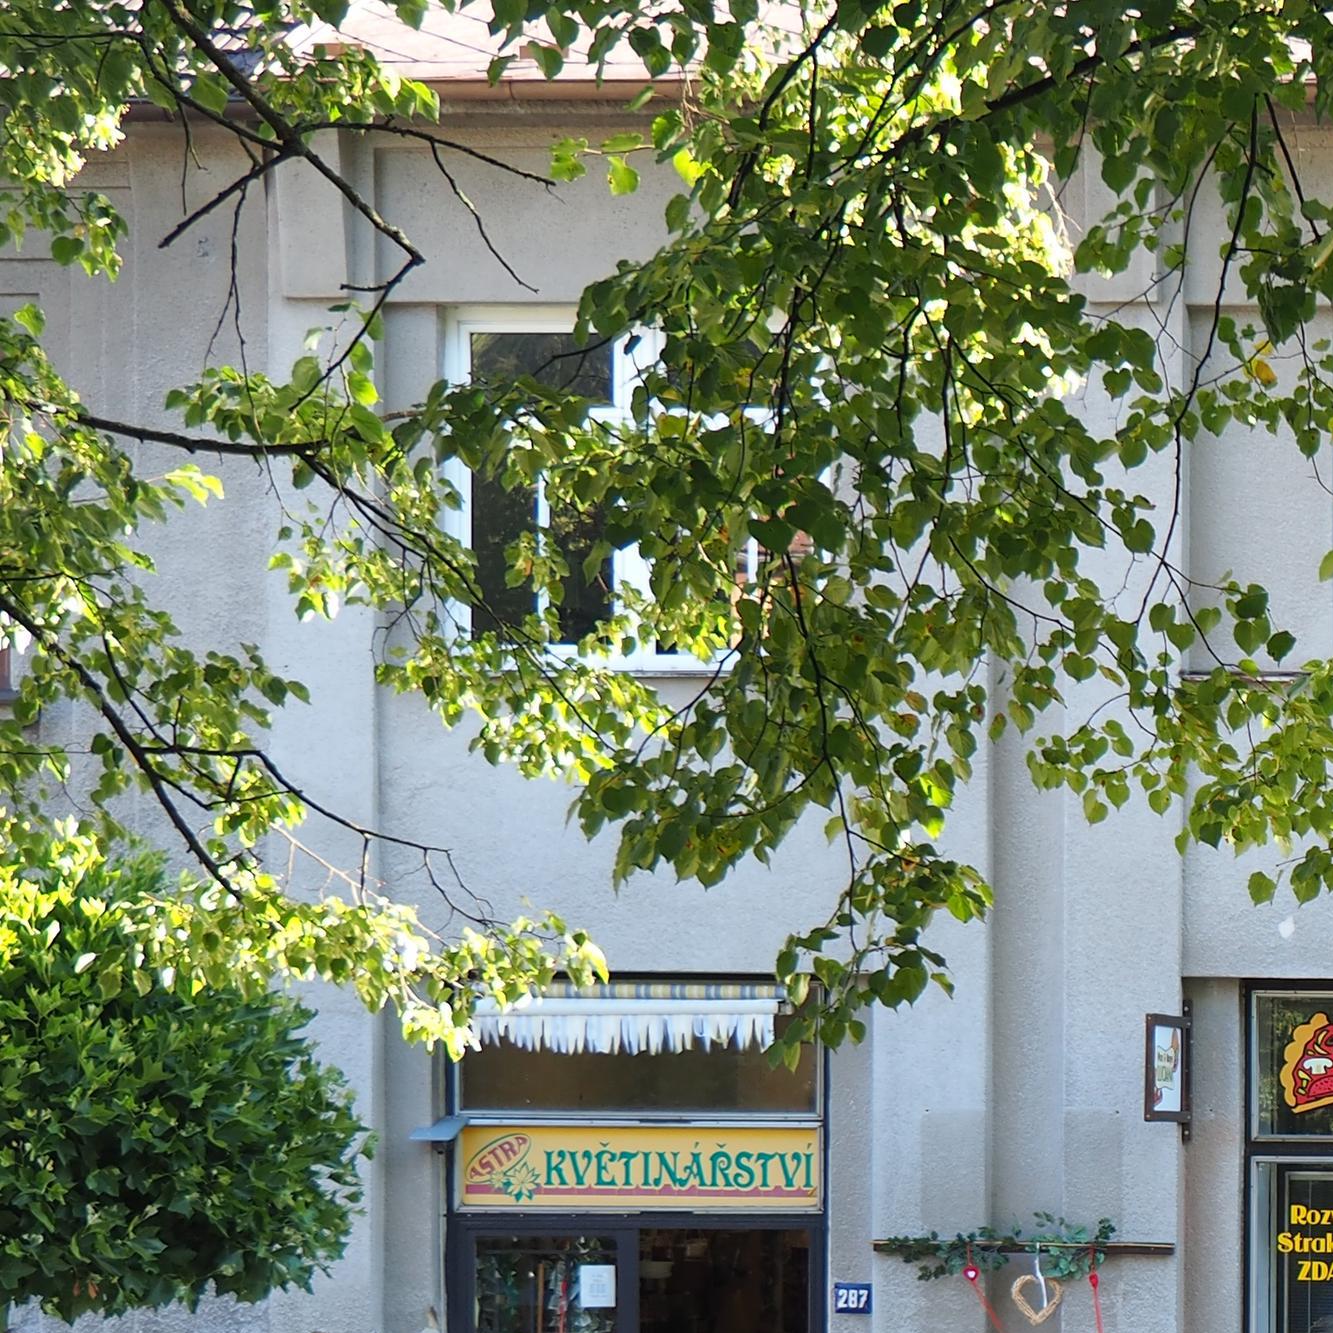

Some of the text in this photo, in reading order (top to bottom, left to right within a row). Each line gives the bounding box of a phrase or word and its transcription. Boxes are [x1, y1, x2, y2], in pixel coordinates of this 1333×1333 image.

[468, 1134, 530, 1181] ASTRA
[543, 1141, 815, 1189] KVĚTINÁŘSTVÍ
[837, 1289, 868, 1308] 287
